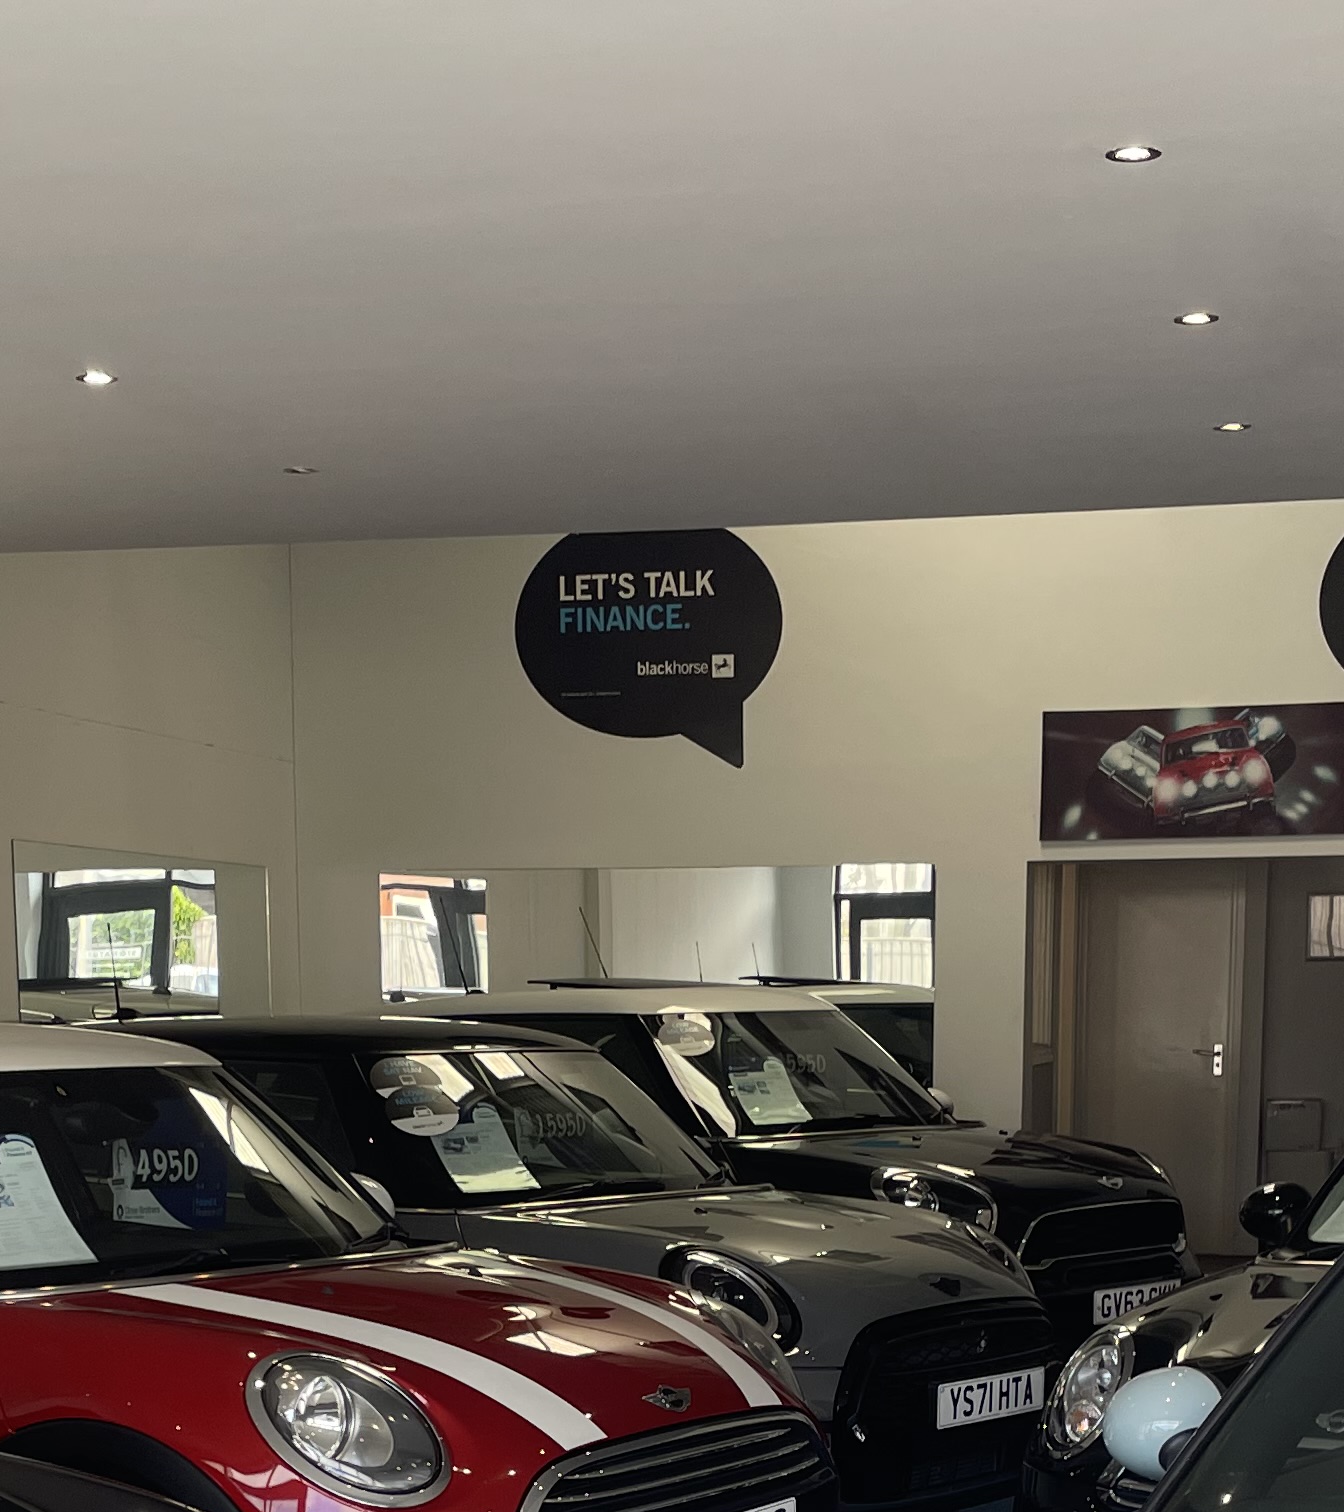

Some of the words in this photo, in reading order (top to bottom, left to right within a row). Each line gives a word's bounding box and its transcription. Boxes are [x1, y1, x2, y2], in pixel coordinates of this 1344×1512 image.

[558, 572, 635, 602] LET'S
[643, 569, 716, 599] TALK
[558, 603, 691, 634] FINANCE.
[636, 660, 709, 676] blackhorse
[136, 1148, 199, 1183] 4950
[950, 1381, 994, 1420] YS71
[998, 1373, 1033, 1411] HTA
